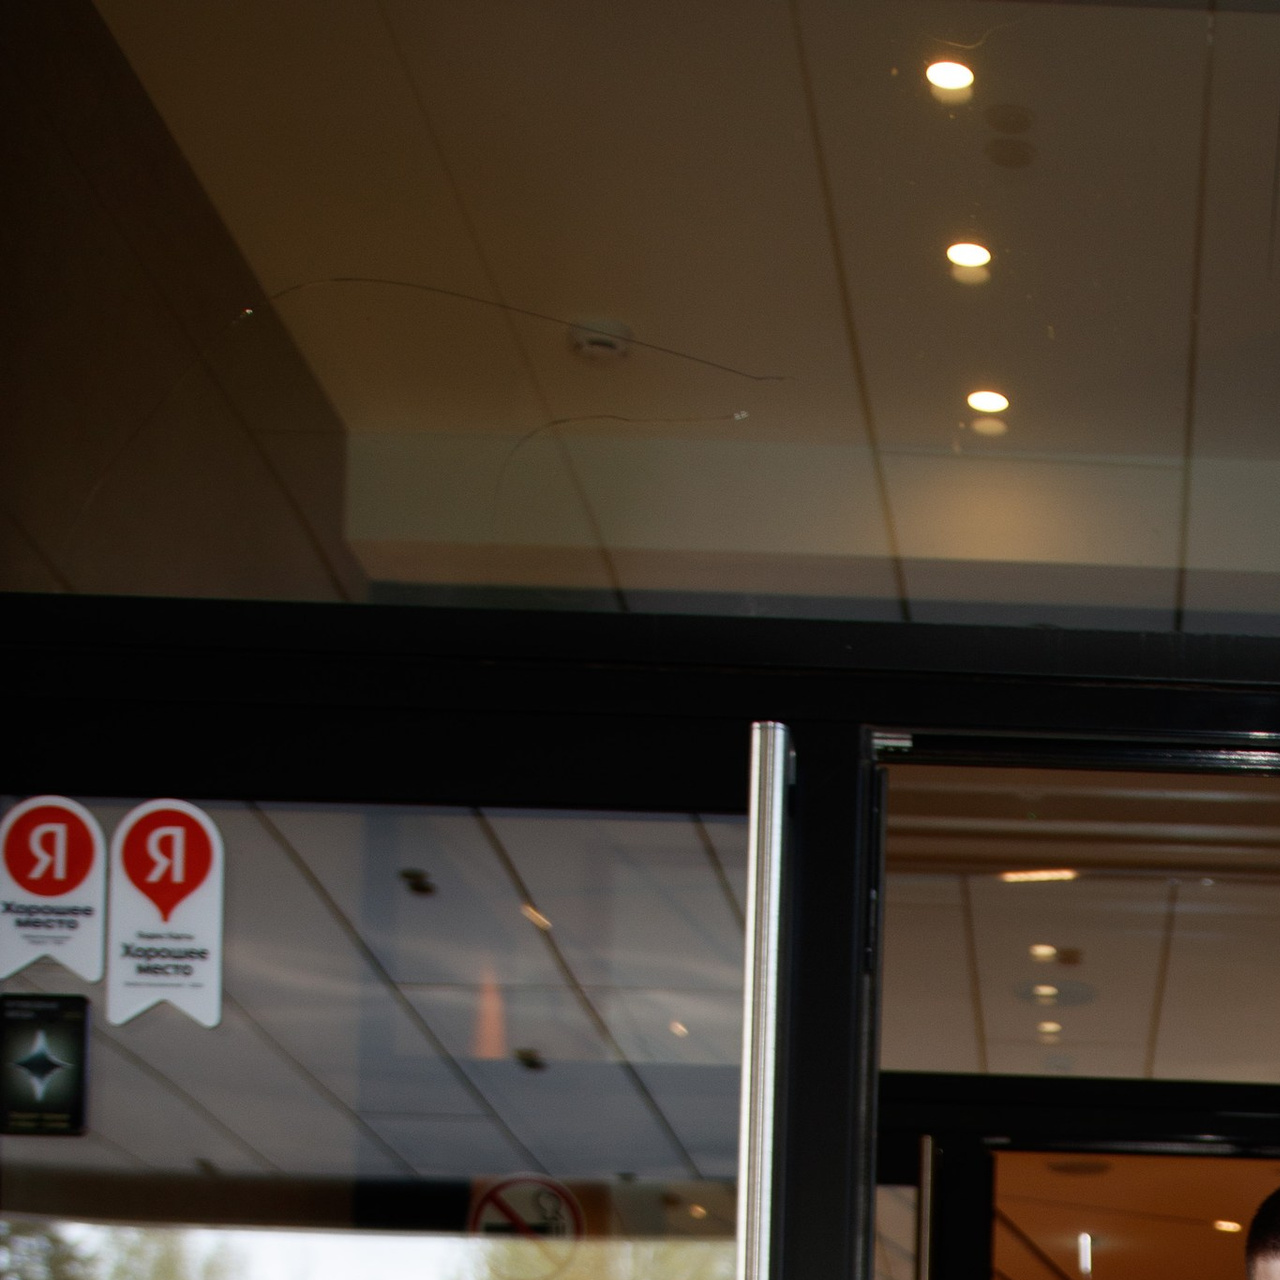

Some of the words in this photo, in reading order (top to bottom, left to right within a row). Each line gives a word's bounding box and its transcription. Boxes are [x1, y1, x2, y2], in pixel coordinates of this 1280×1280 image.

[28, 822, 67, 881] Я
[145, 826, 185, 884] Я
[2, 902, 93, 917] Хорошее
[15, 917, 78, 930] место
[121, 943, 209, 961] Хорошее
[136, 963, 192, 976] место
